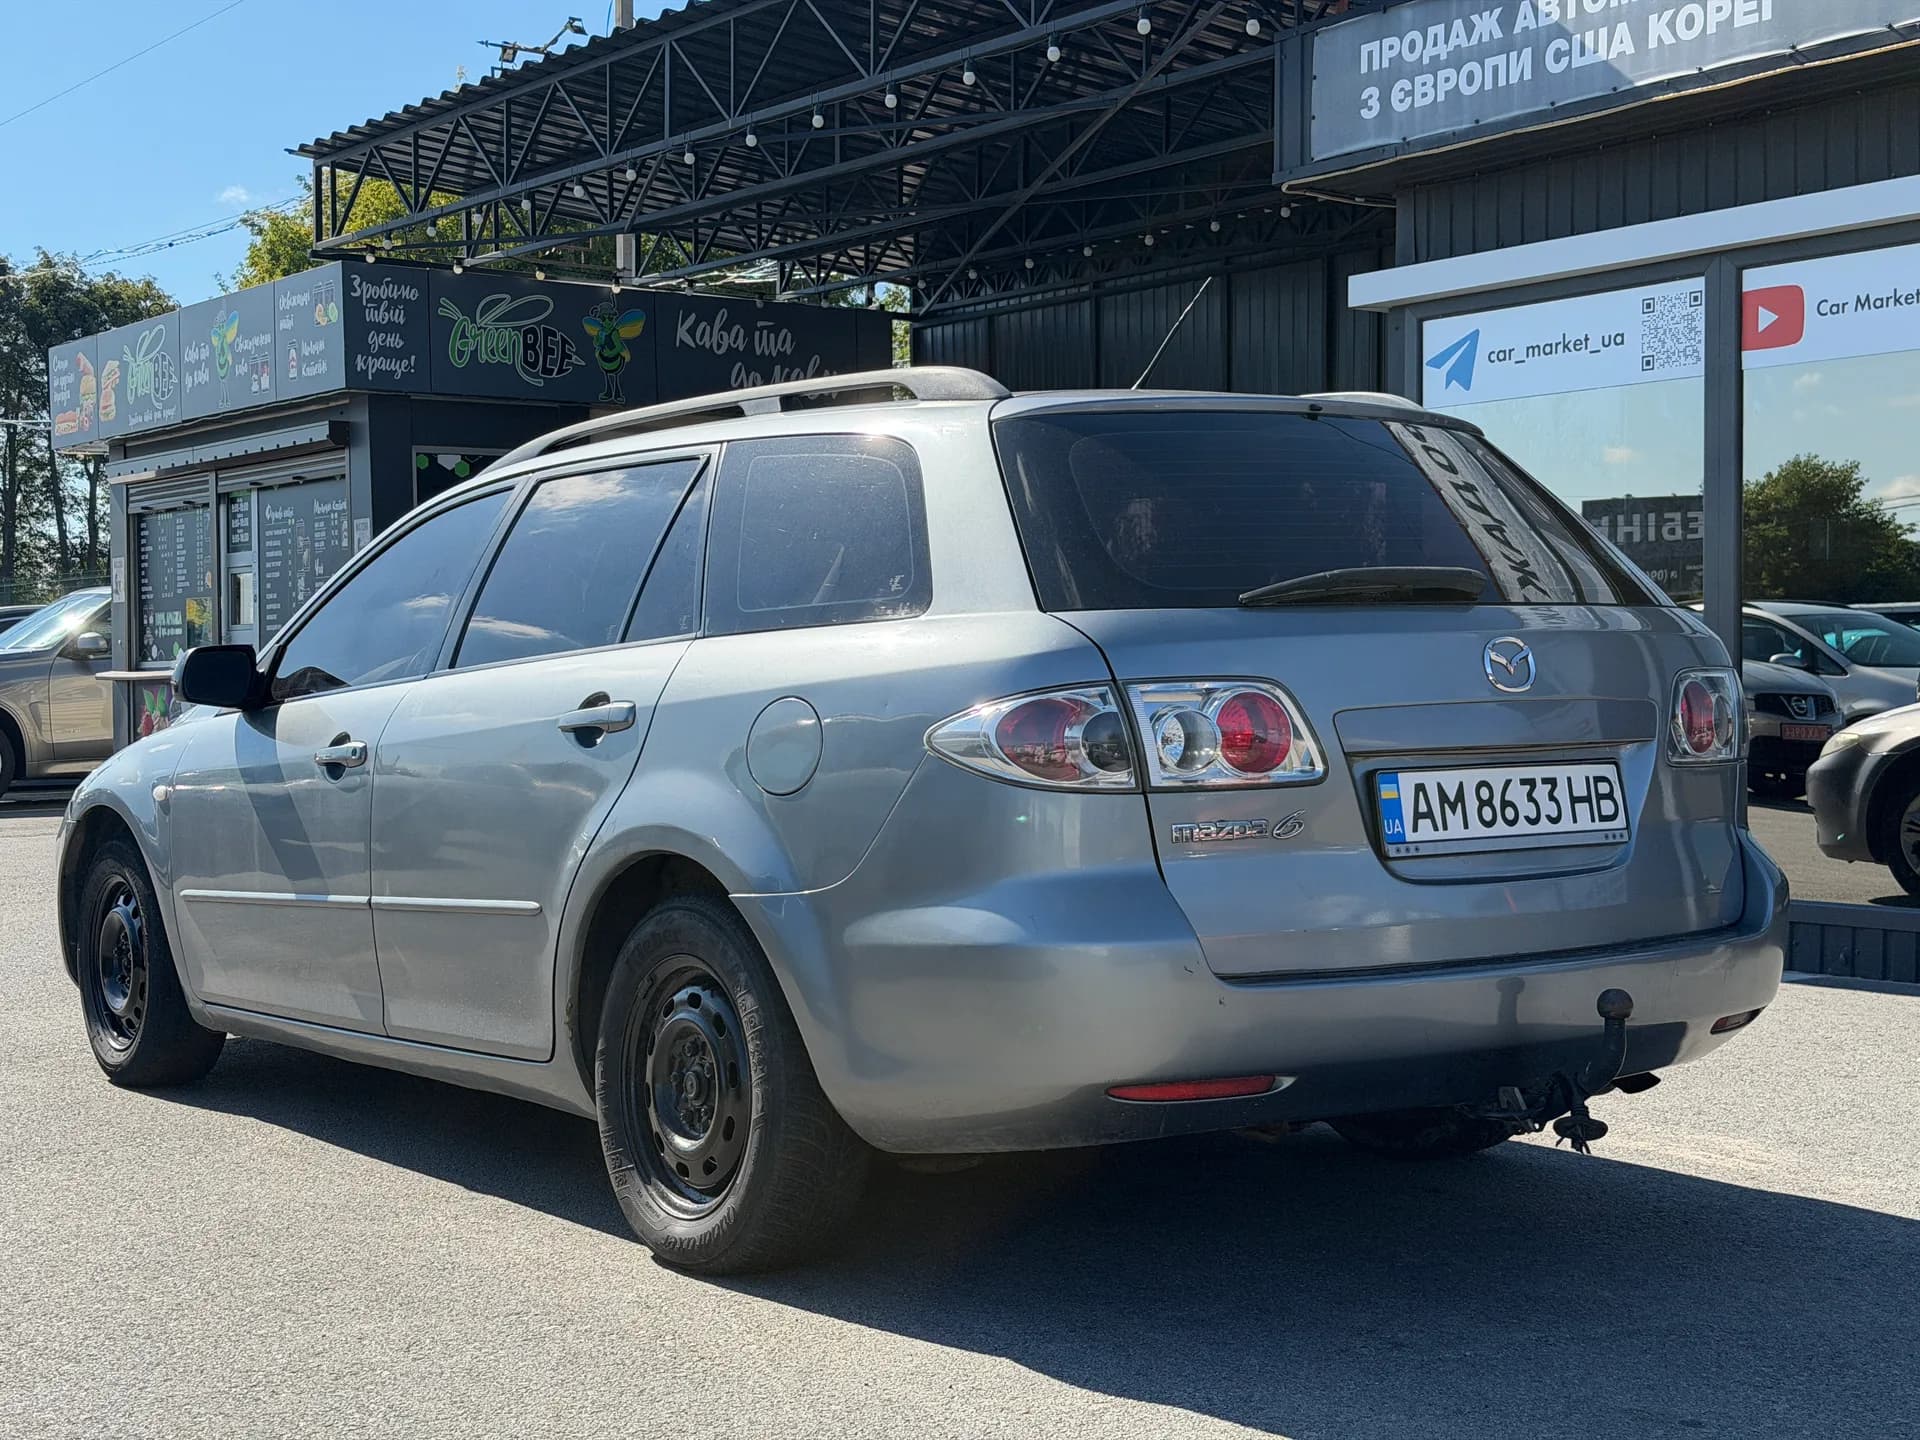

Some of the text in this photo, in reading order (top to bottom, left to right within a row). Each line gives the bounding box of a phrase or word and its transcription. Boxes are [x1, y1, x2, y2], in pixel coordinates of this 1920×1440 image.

[1360, 0, 1634, 74] ПРОДАЖ АВТ
[1390, 47, 1533, 112] ЄВРОПИ
[1544, 21, 1635, 74] США
[351, 275, 420, 307] Зробимо
[1816, 288, 1920, 317] Car Market
[365, 300, 406, 325] твій
[368, 330, 404, 354] день
[676, 308, 796, 358] Кава та
[1487, 332, 1625, 364] car_market_ua
[355, 353, 416, 381] краще!
[1384, 819, 1403, 836] UA
